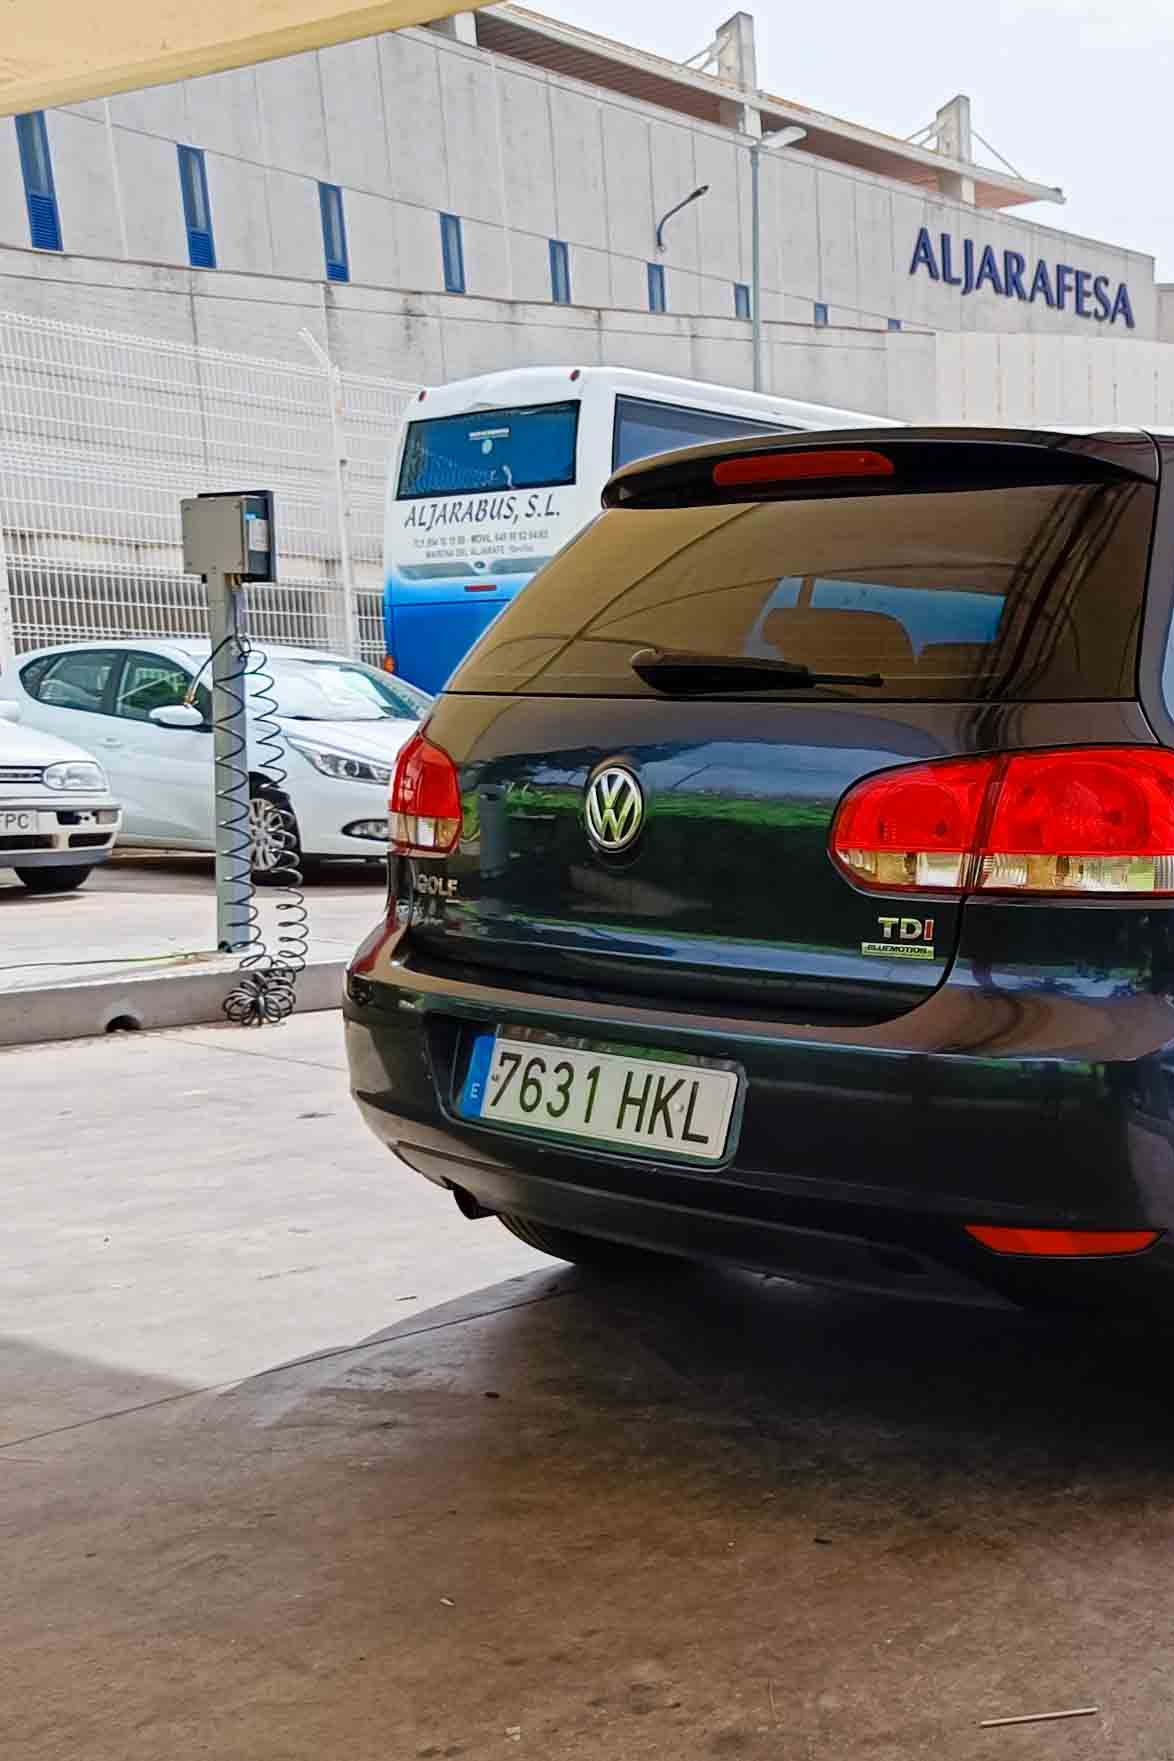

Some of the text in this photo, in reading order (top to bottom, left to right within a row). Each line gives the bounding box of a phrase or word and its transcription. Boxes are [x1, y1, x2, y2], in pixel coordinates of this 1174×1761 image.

[909, 227, 1135, 329] ALJARAFESA
[404, 494, 560, 531] ALJARABUS, S.L.
[0, 813, 29, 829] PC
[417, 874, 458, 897] GOLF
[878, 916, 934, 940] TDI
[471, 1052, 709, 1145] E 7631 HKL
